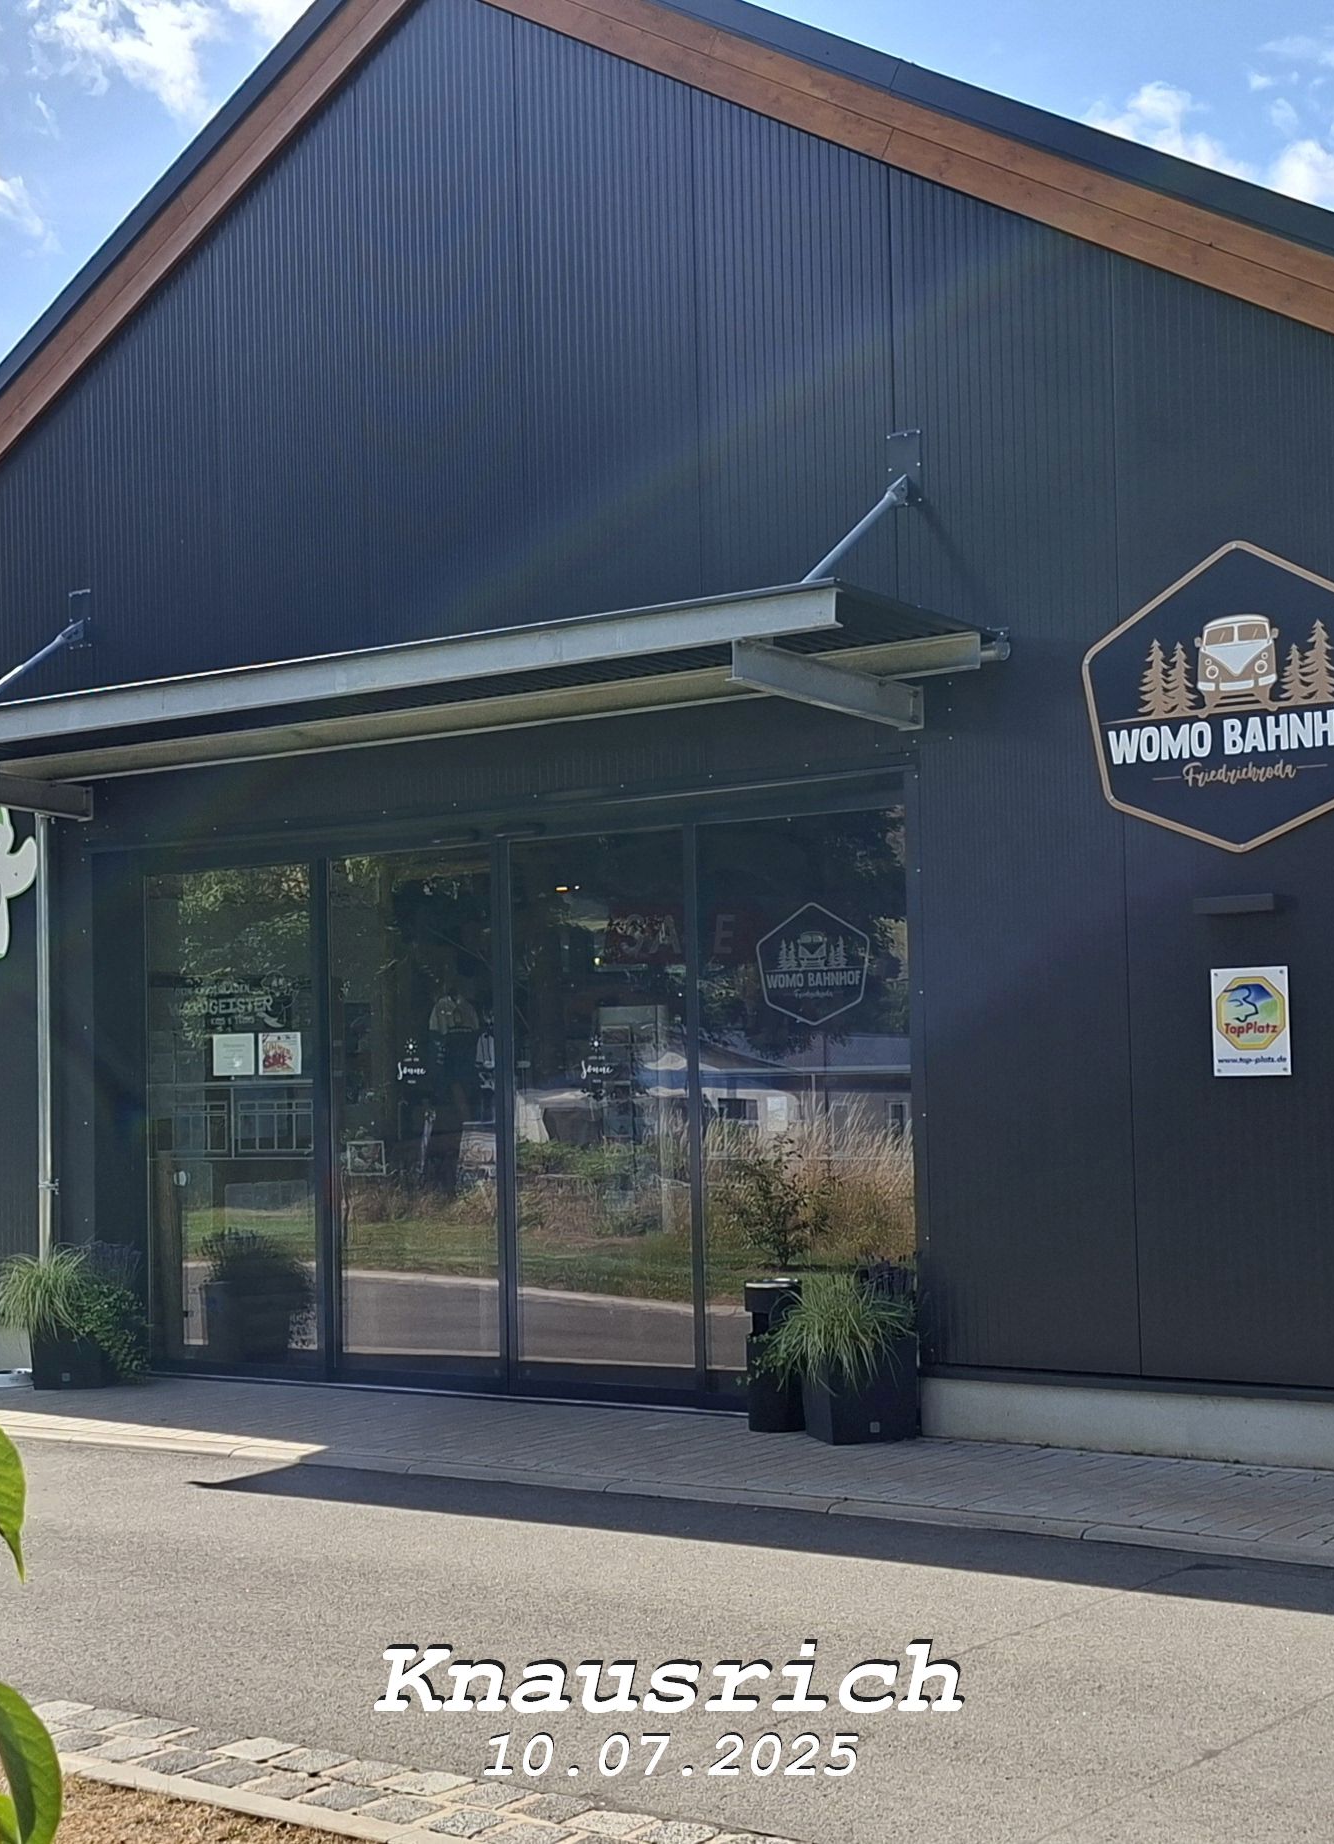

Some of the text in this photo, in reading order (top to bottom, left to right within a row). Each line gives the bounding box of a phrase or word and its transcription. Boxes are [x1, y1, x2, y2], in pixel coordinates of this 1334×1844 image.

[1108, 721, 1212, 765] WOMO
[1182, 759, 1297, 788] Friedrichroda
[619, 913, 736, 955] SAE
[766, 970, 862, 989] WOMO BAHNHOF
[1223, 1021, 1278, 1038] TopPlatz
[1218, 1055, 1287, 1065] www.top-platz.de
